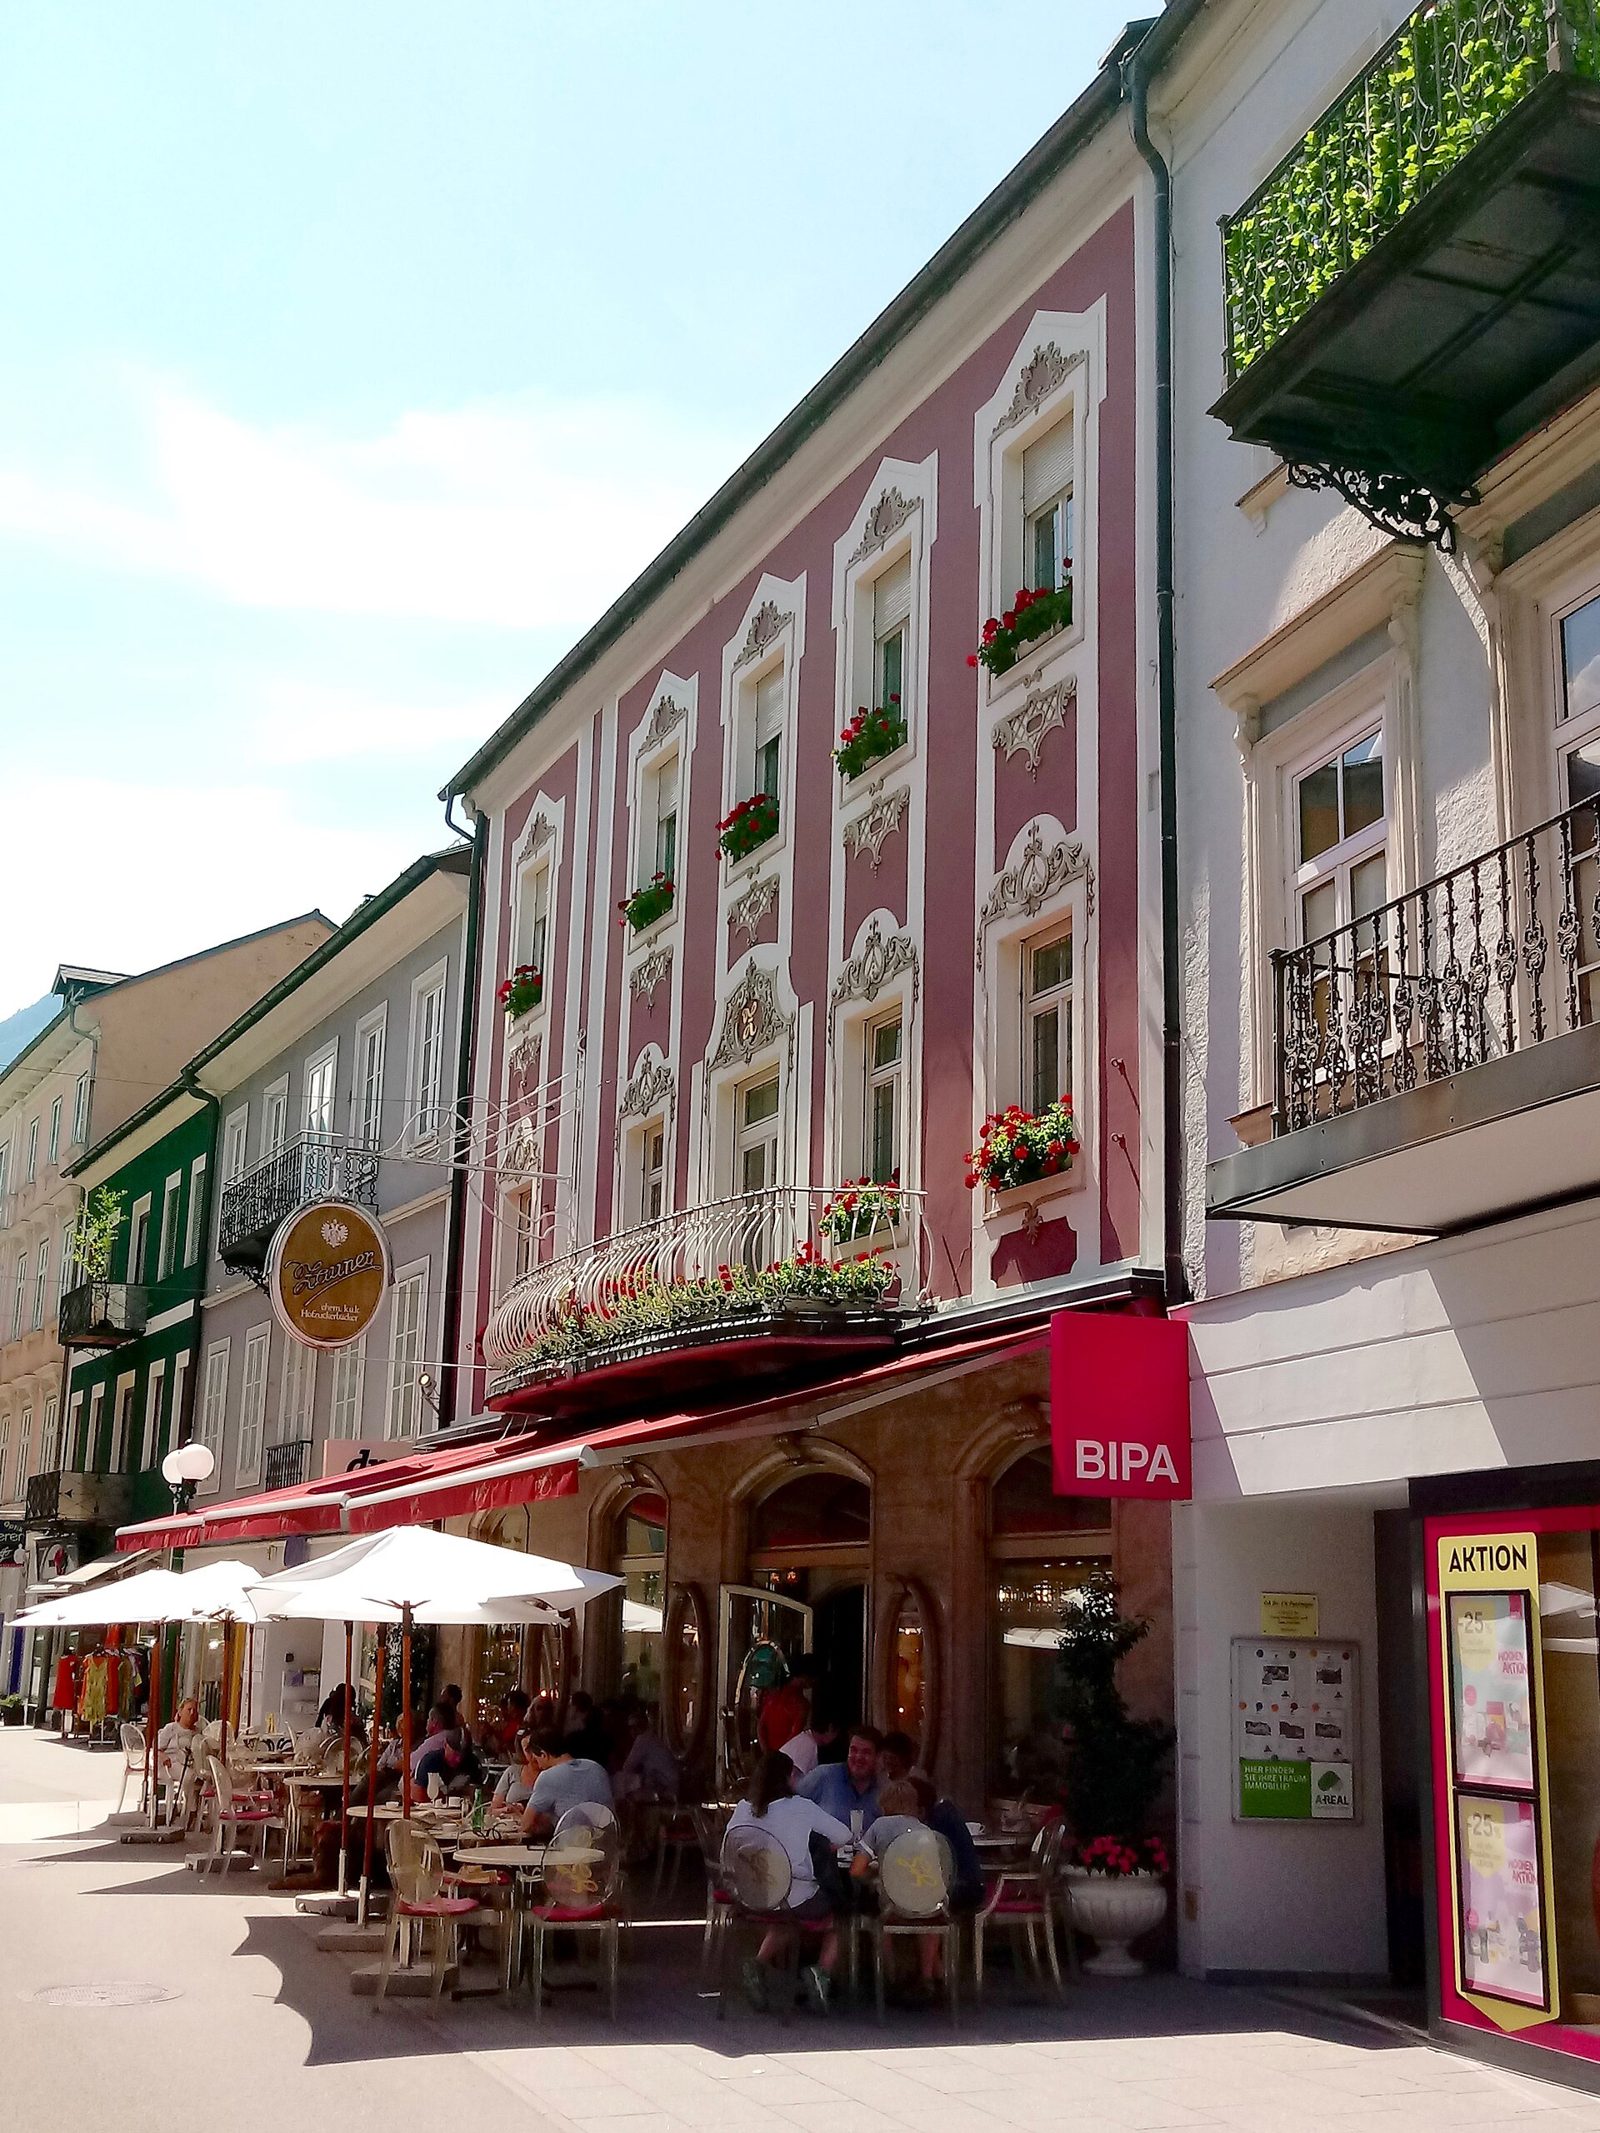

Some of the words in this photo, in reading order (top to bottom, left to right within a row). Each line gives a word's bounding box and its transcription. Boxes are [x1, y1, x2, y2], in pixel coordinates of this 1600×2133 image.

[284, 1251, 378, 1296] Zauner
[1076, 1439, 1179, 1483] BIPA
[4, 1521, 23, 1532] Optik
[1449, 1545, 1527, 1572] AKTION
